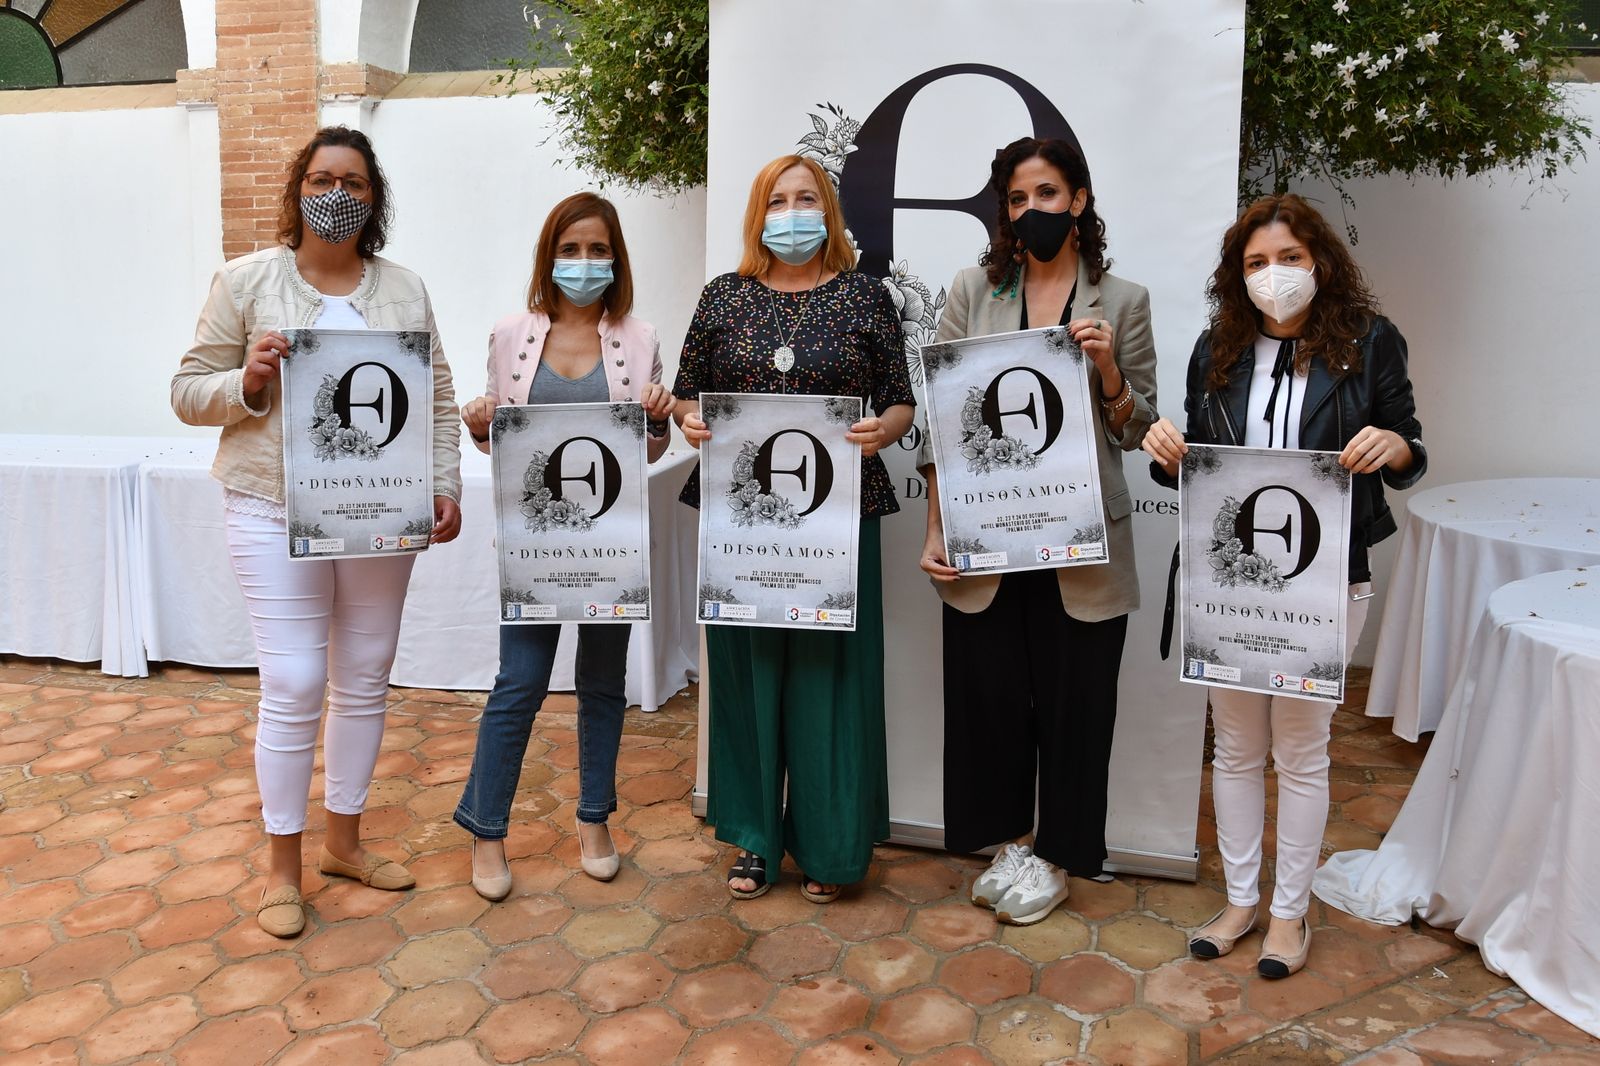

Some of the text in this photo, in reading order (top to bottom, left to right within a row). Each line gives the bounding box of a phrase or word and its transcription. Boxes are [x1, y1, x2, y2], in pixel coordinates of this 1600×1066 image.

[996, 520, 1024, 528] MONASTERIO
[1234, 638, 1263, 647] MONASTERIO
[1281, 644, 1307, 652] FRANCISCO
